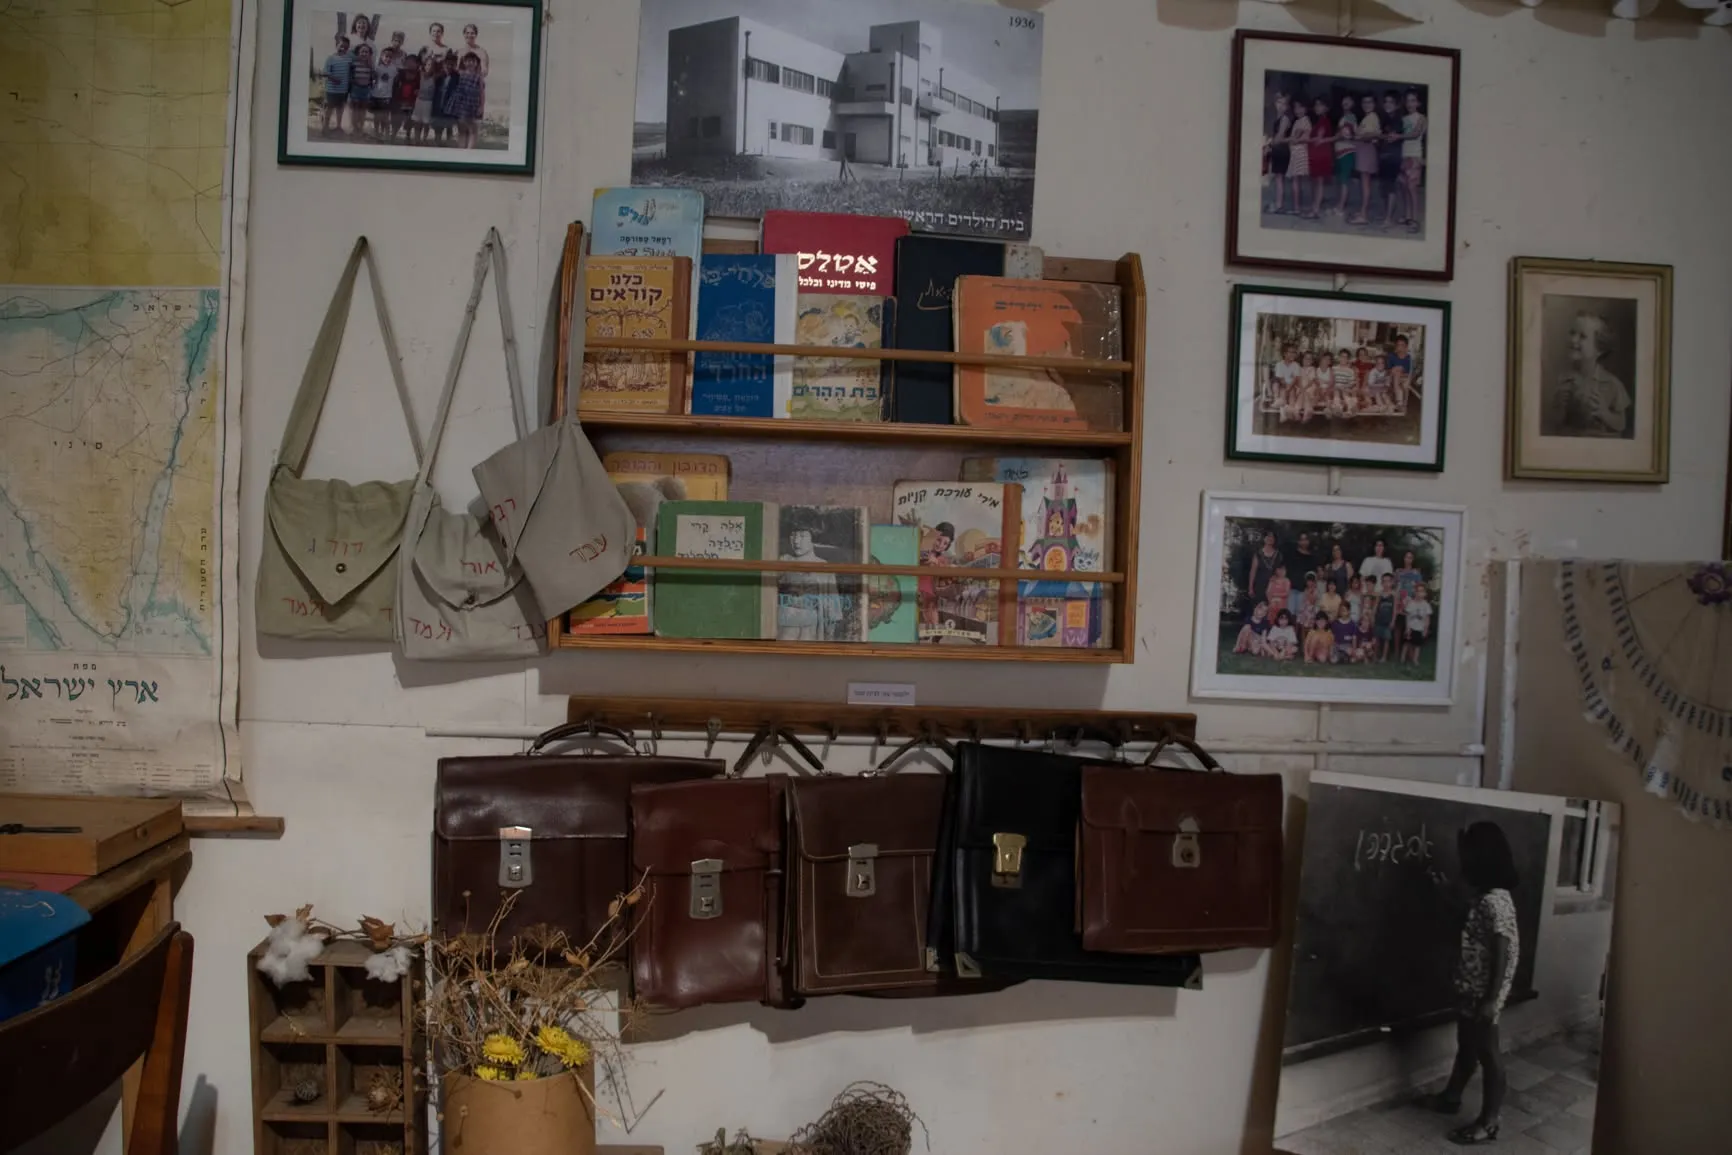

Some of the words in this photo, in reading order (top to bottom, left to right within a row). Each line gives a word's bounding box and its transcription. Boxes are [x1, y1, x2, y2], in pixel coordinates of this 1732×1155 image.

[1008, 16, 1036, 30] 1936
[947, 211, 996, 229] הילדים
[998, 217, 1025, 232] בית
[796, 250, 878, 275] אטלס
[610, 273, 643, 287] כלנו
[798, 276, 823, 287] וכלכל
[826, 279, 852, 289] מדיני
[590, 287, 663, 306] קוראים
[792, 383, 847, 401] ההרים
[850, 386, 877, 400] בת
[673, 461, 718, 479] הדובון
[897, 489, 928, 506] קניות
[934, 488, 973, 498] עורכת
[977, 492, 1000, 508] מירי
[720, 519, 744, 533] אלה
[327, 538, 364, 556] דוד
[708, 536, 744, 551] הילדה
[459, 559, 500, 575] אור
[72, 662, 97, 672] מפת
[0, 664, 95, 702] ישראל
[107, 678, 159, 712] ארץ
